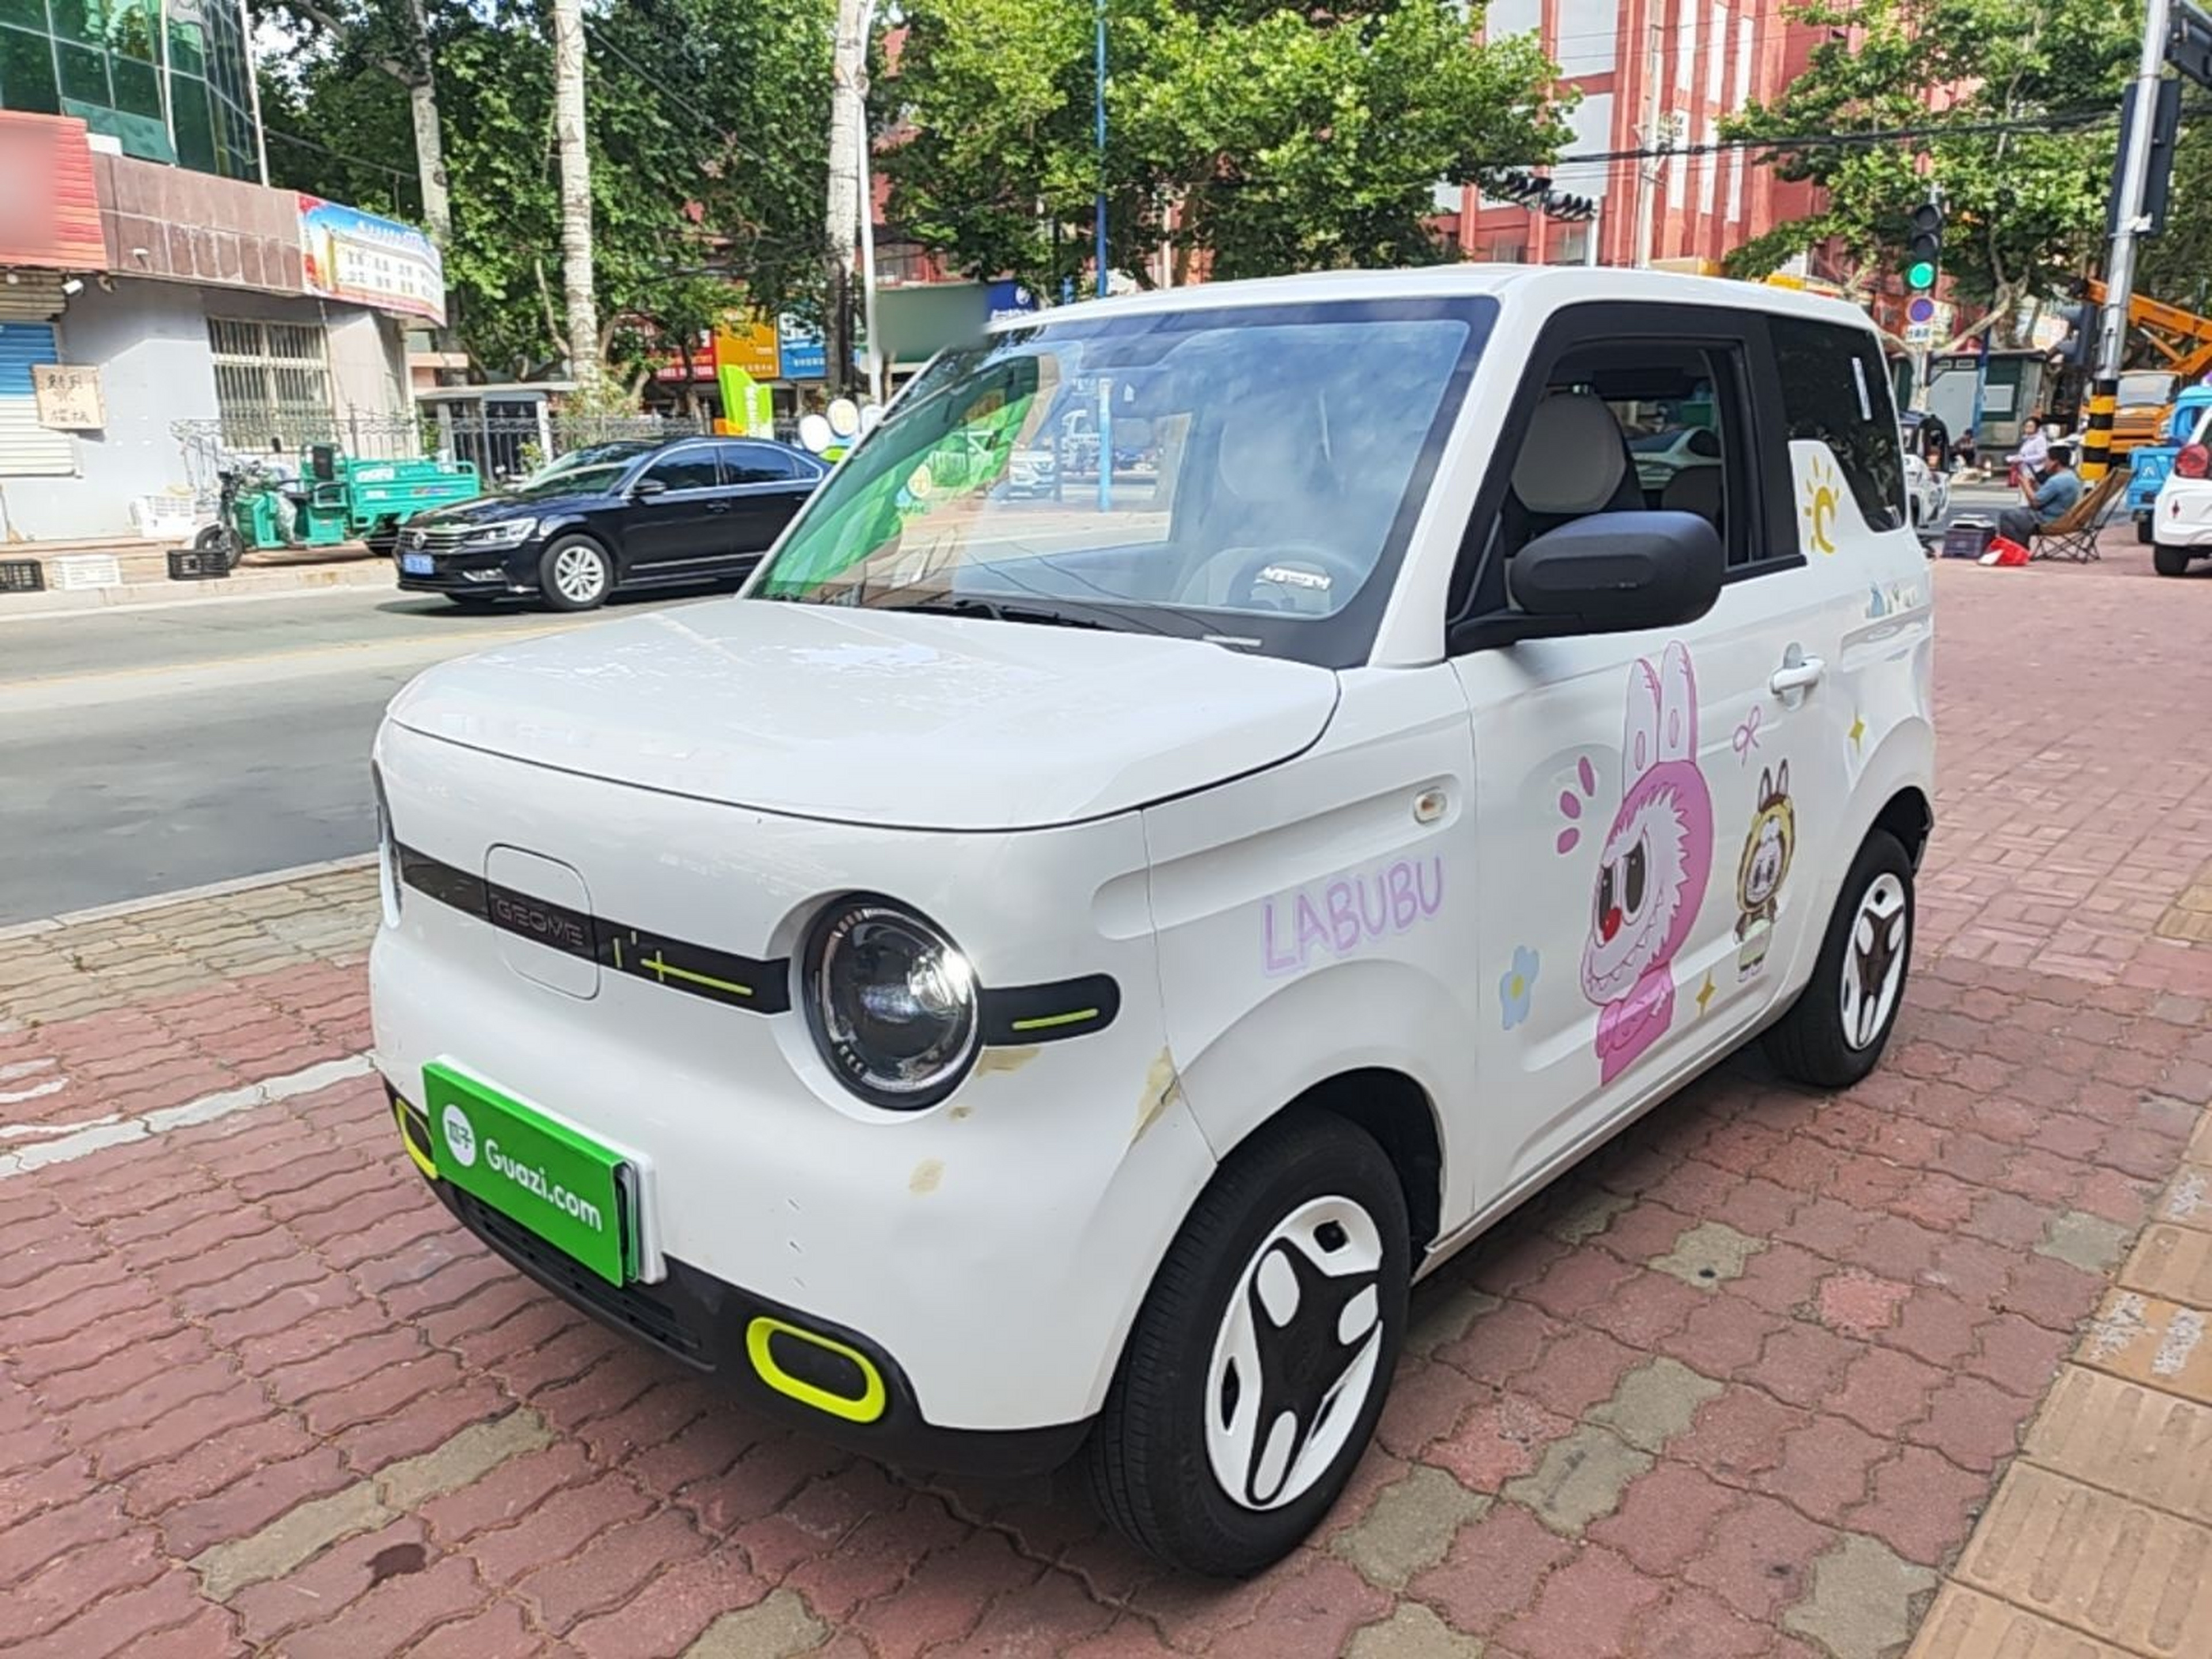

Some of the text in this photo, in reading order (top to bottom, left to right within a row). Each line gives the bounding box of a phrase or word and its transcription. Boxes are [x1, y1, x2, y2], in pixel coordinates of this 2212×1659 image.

[497, 898, 584, 946] GEOME
[1264, 854, 1442, 972] LABUBU
[484, 1138, 602, 1232] Guazi.com
